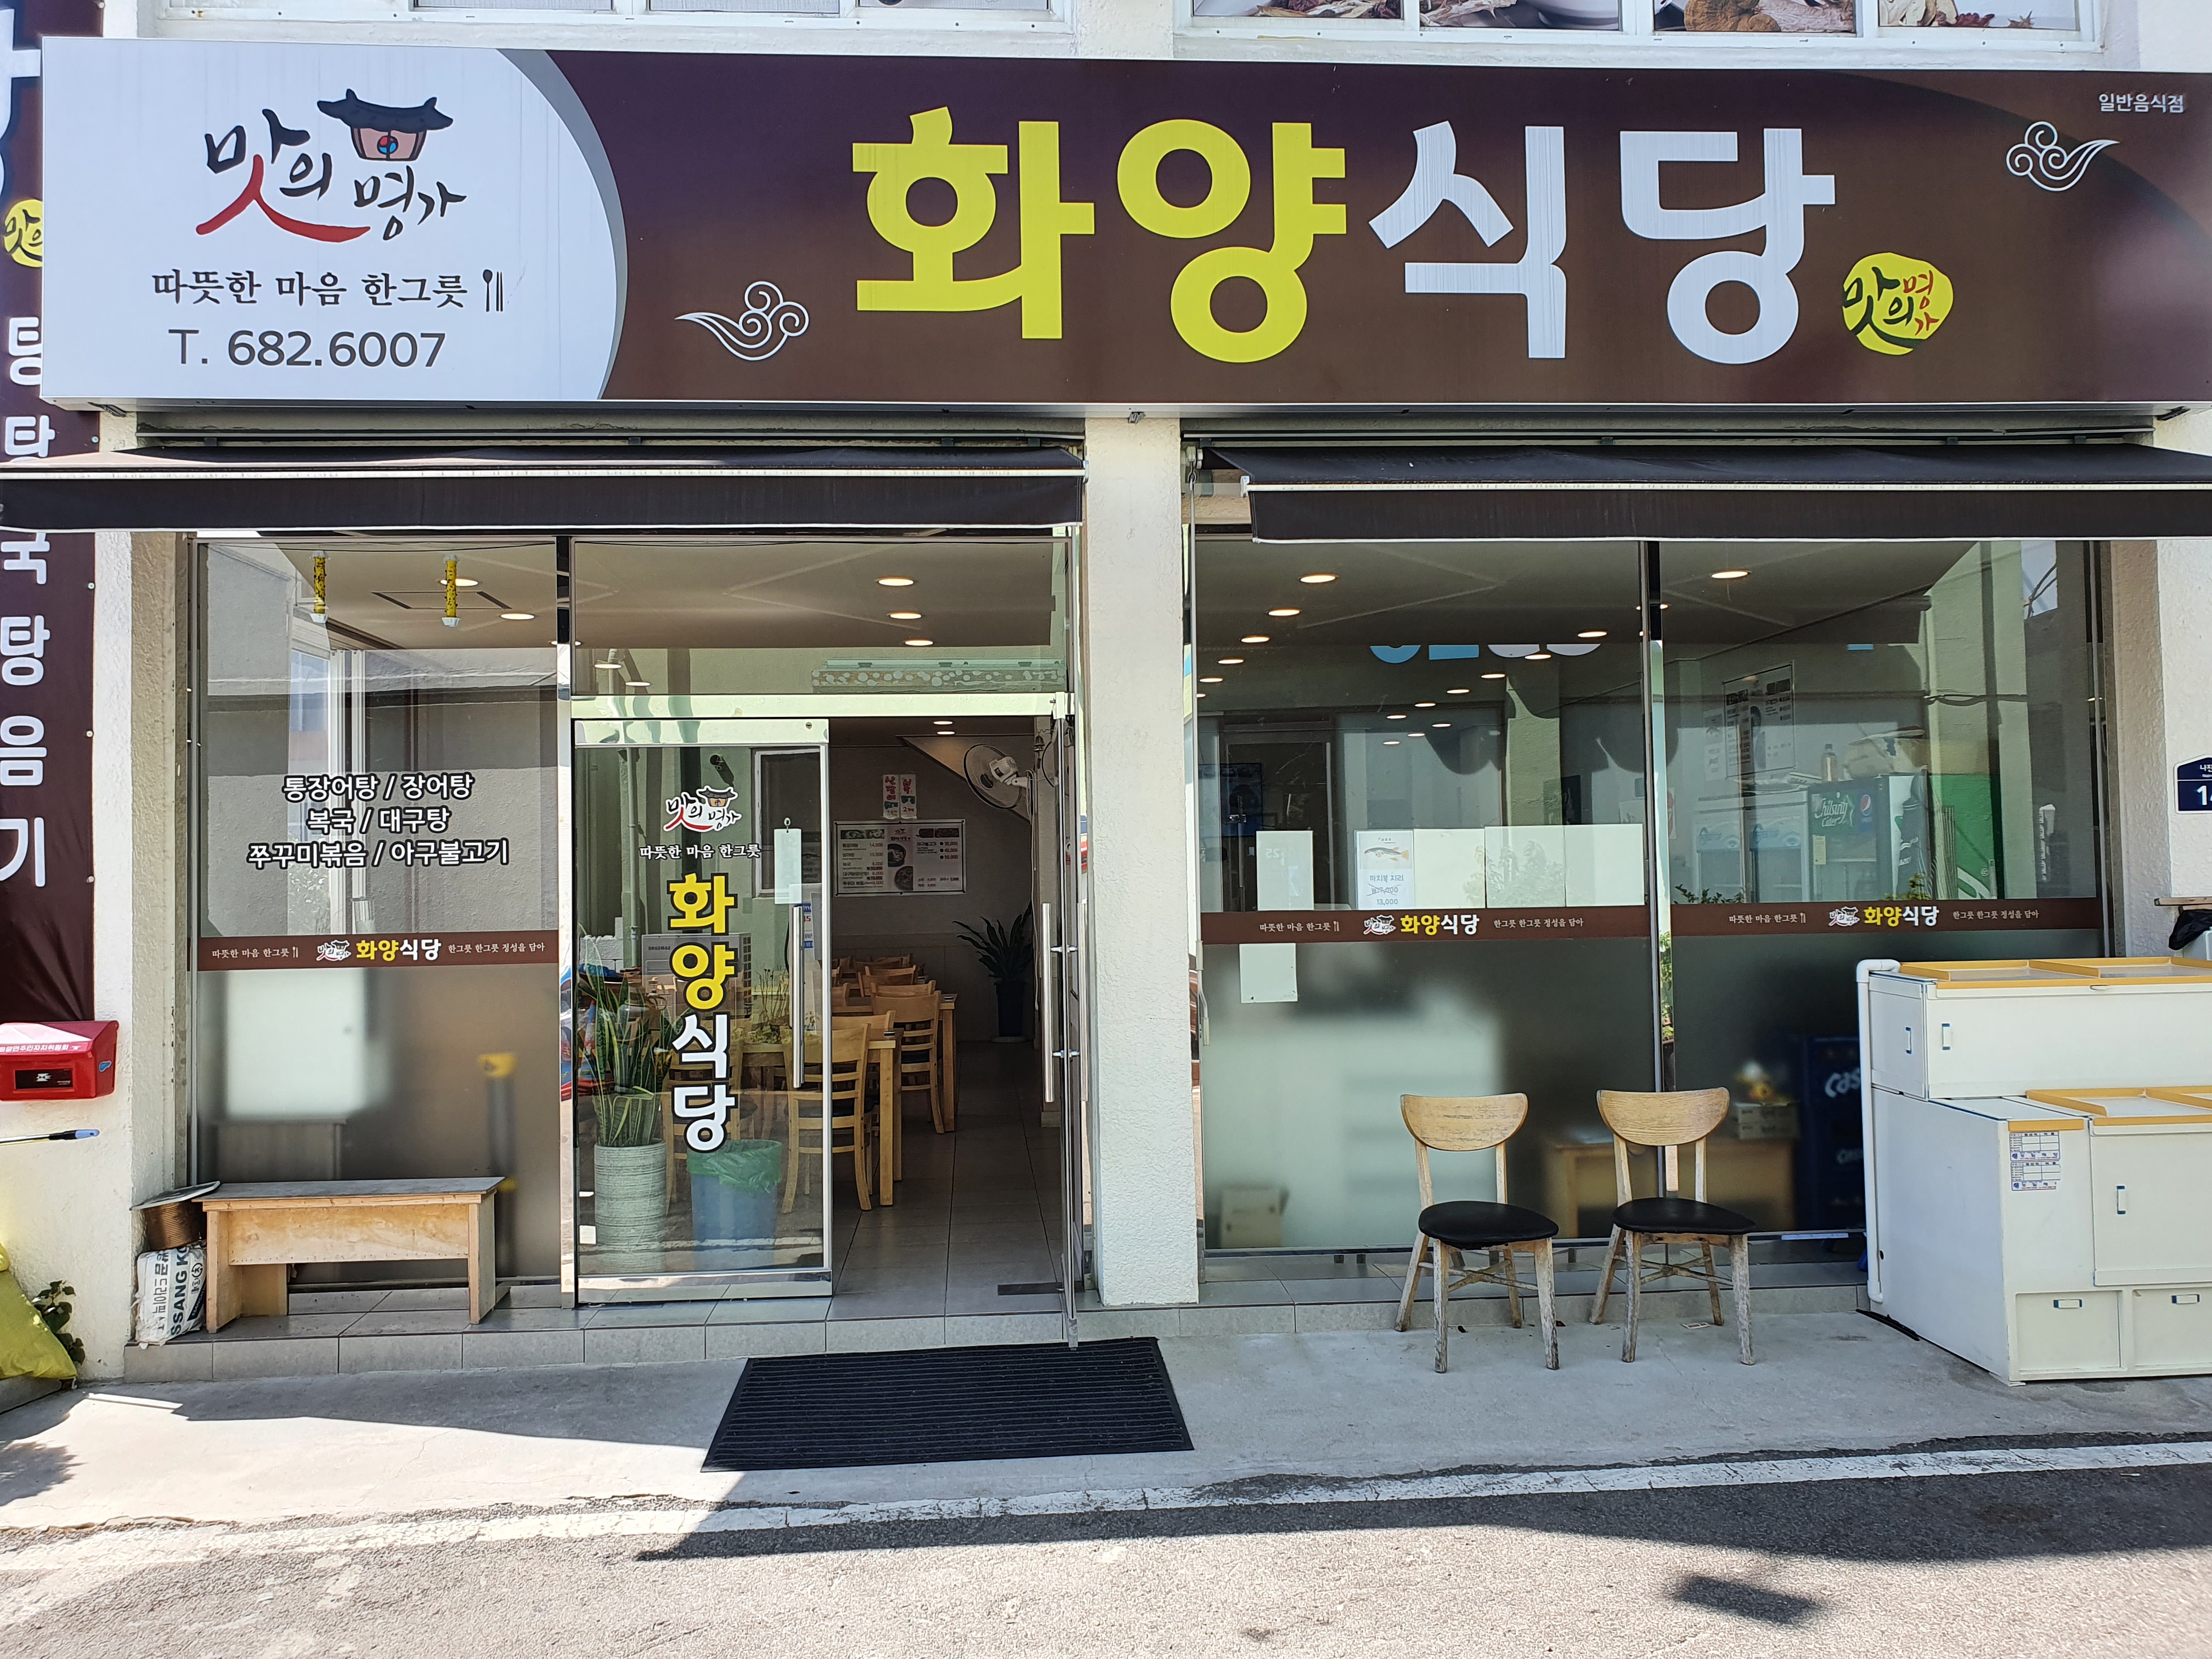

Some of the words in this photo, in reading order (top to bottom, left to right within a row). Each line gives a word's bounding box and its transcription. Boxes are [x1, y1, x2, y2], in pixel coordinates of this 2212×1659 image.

[2099, 93, 2184, 113] 일반음식점
[196, 108, 371, 242] 맛의
[353, 165, 467, 241] 명가
[852, 106, 1836, 364] 화양식당
[152, 268, 262, 306] 따뜻한
[276, 271, 348, 307] 마음
[361, 272, 468, 311] 한그릇
[168, 329, 208, 365] T.
[228, 330, 445, 368] 682.6007
[284, 775, 378, 800] 통장어탕
[403, 774, 473, 799] 장어탕
[308, 810, 355, 833] 복국
[380, 808, 450, 832] 대구탕
[249, 844, 366, 868] 쭈꾸미볶음
[392, 840, 507, 865] 아구불고기
[640, 845, 681, 860] 따뜻한
[687, 845, 714, 859] 마음
[719, 844, 761, 858] 한그릇
[1400, 915, 1480, 935] 화양식당
[1493, 919, 1516, 928] 한그릇
[1519, 919, 1541, 928] 한그릇
[1543, 918, 1566, 927] 정성을
[1569, 918, 1583, 927] 담아
[1729, 915, 1753, 924] 따뜻한
[1756, 915, 1771, 923] 마음
[1774, 914, 1798, 923] 한그릇
[1864, 906, 1939, 927] 화양식당
[1953, 911, 1974, 920] 한그릇
[1977, 911, 1998, 919] 한그릇
[2000, 910, 2022, 919] 정성을
[2024, 910, 2039, 919] 담아
[1260, 923, 1284, 932] 따뜻한
[1287, 923, 1304, 932] 마음
[1306, 922, 1331, 932] 한그릇
[212, 950, 239, 959] 따뜻한
[241, 949, 260, 958] 마음
[263, 949, 290, 957] 한그릇
[356, 939, 441, 961] 화양식당
[448, 944, 472, 953] 한그릇
[475, 944, 499, 953] 한그릇
[502, 943, 526, 952] 정성을
[529, 943, 545, 952] 담아
[668, 872, 735, 1152] 화양식당
[171, 1271, 188, 1335] SSANG
